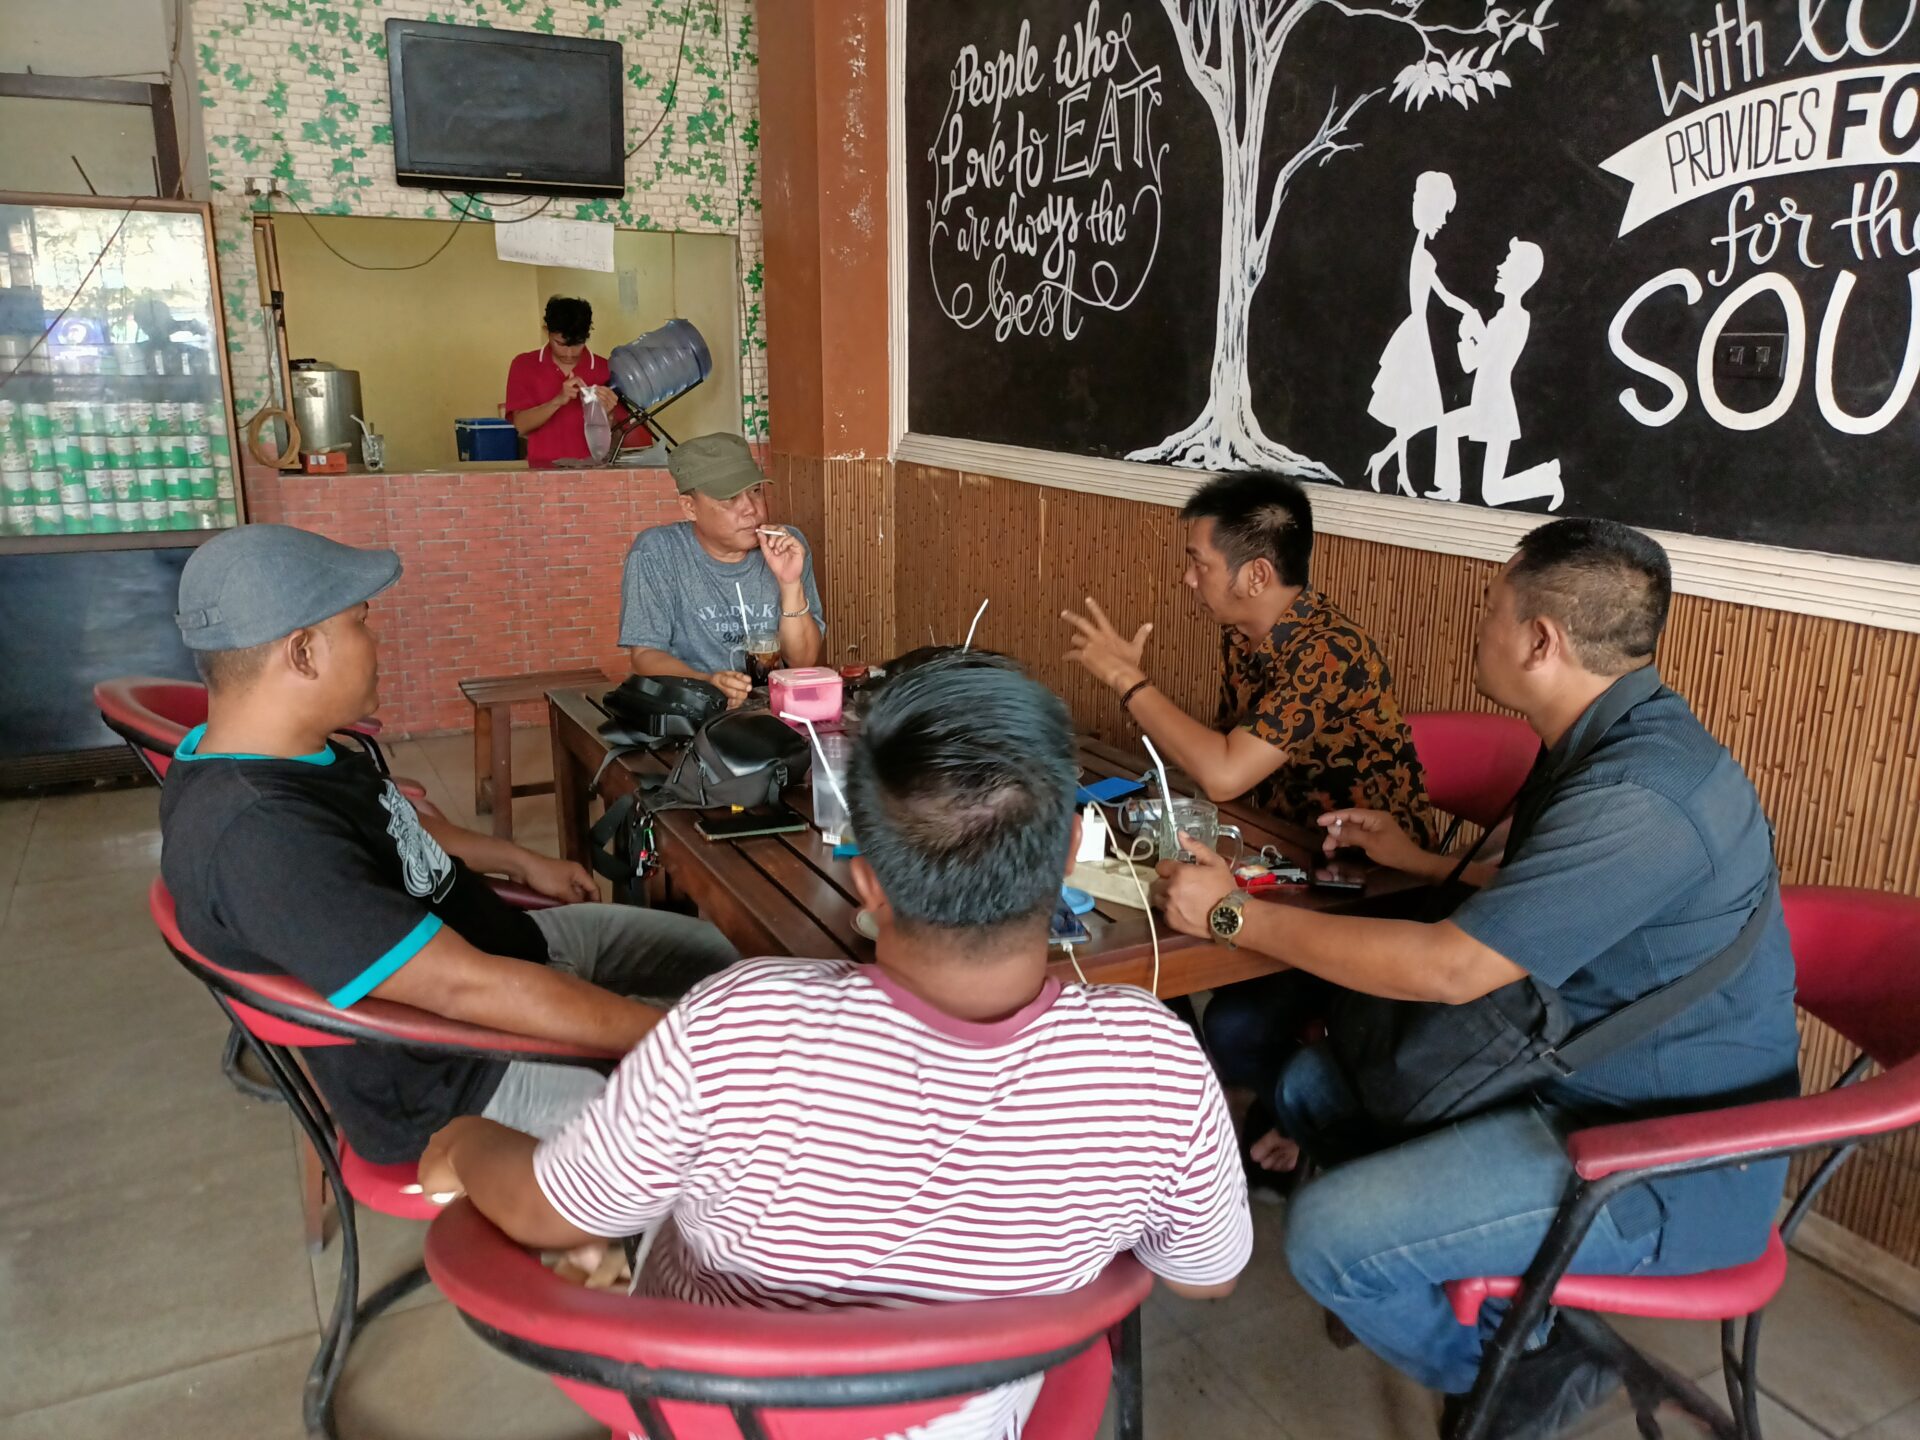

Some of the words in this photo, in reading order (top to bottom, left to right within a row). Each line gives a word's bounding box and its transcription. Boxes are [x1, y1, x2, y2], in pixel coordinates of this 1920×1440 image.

[951, 18, 1046, 123] People
[1053, 0, 1133, 89] who
[941, 113, 1006, 215] Love
[1008, 111, 1048, 198] to
[1053, 65, 1161, 183] EAT
[1666, 87, 1820, 194] PROVIDES
[957, 206, 990, 261] are
[1086, 179, 1127, 246] the
[1707, 186, 1824, 286] for
[1831, 170, 1920, 259] th
[988, 250, 1084, 342] best
